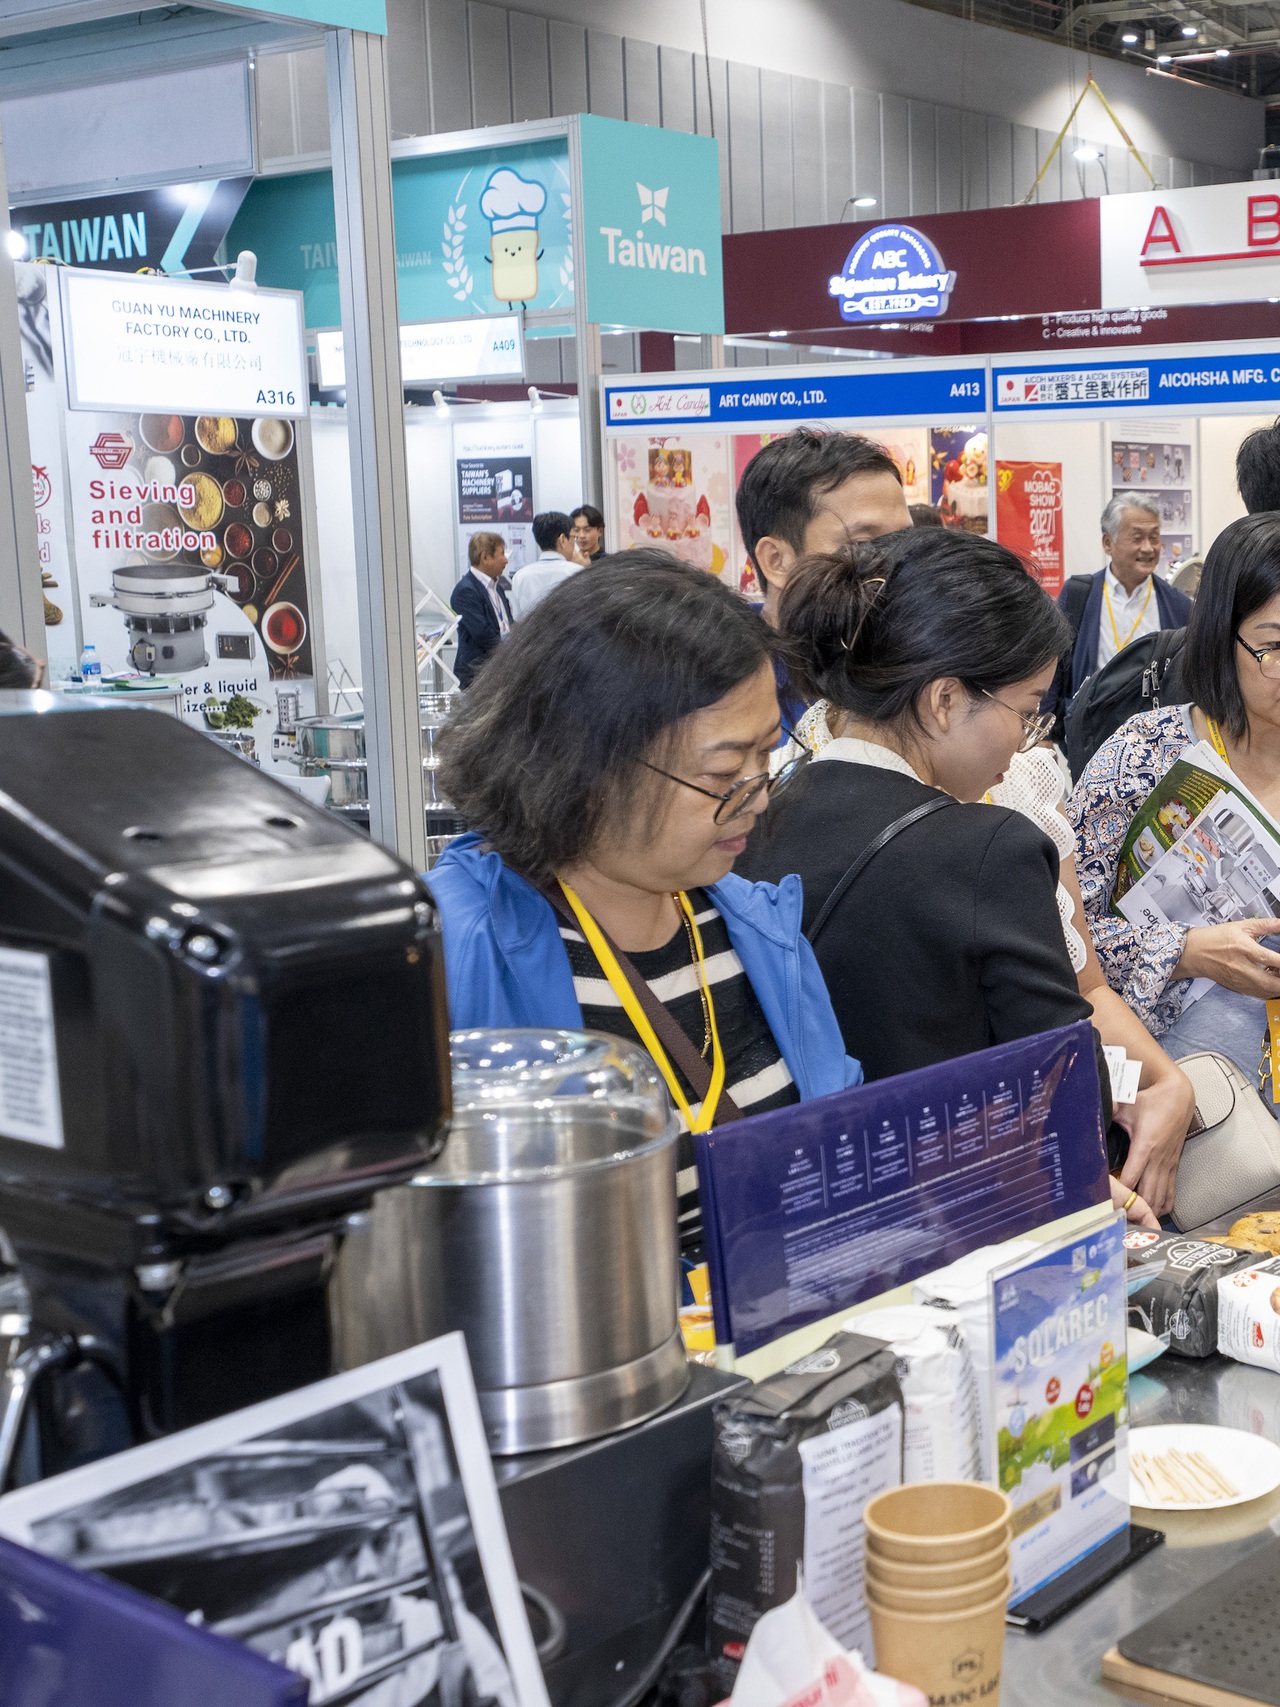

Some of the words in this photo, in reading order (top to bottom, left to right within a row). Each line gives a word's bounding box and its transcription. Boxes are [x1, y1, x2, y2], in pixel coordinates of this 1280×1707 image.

[22, 212, 148, 264] TAIWAN
[396, 250, 431, 268] AIWAN
[600, 227, 707, 276] Taiwan
[871, 249, 907, 270] ABC
[111, 300, 153, 316] GUAN
[159, 304, 175, 318] YU
[179, 307, 261, 325] MACHINERY
[125, 321, 190, 339] FACTORY
[194, 328, 221, 344] CO.,
[223, 330, 251, 344] LTD.
[492, 339, 515, 352] A409
[1111, 370, 1147, 380] SYSTEMS
[1159, 369, 1230, 388] AICOHSHA
[1232, 368, 1268, 385] MFG.
[256, 389, 296, 406] A316
[719, 394, 740, 408] ART
[741, 392, 779, 407] CANDY
[781, 390, 800, 407] CO.,
[802, 389, 827, 405] LTD.
[950, 382, 980, 397] A413
[461, 469, 489, 478] TAIWAN'S
[461, 477, 495, 487] MACHINERY
[89, 480, 195, 505] Sieving
[462, 486, 492, 496] SUPPLIERS
[1024, 480, 1056, 493] MOBAC
[1029, 494, 1055, 506] SHOW
[91, 505, 142, 525] and
[1030, 508, 1052, 535] 2027
[92, 530, 216, 550] filtration
[203, 682, 213, 694] &
[218, 678, 258, 695] liquid
[1013, 1293, 1109, 1374] SOLAREC
